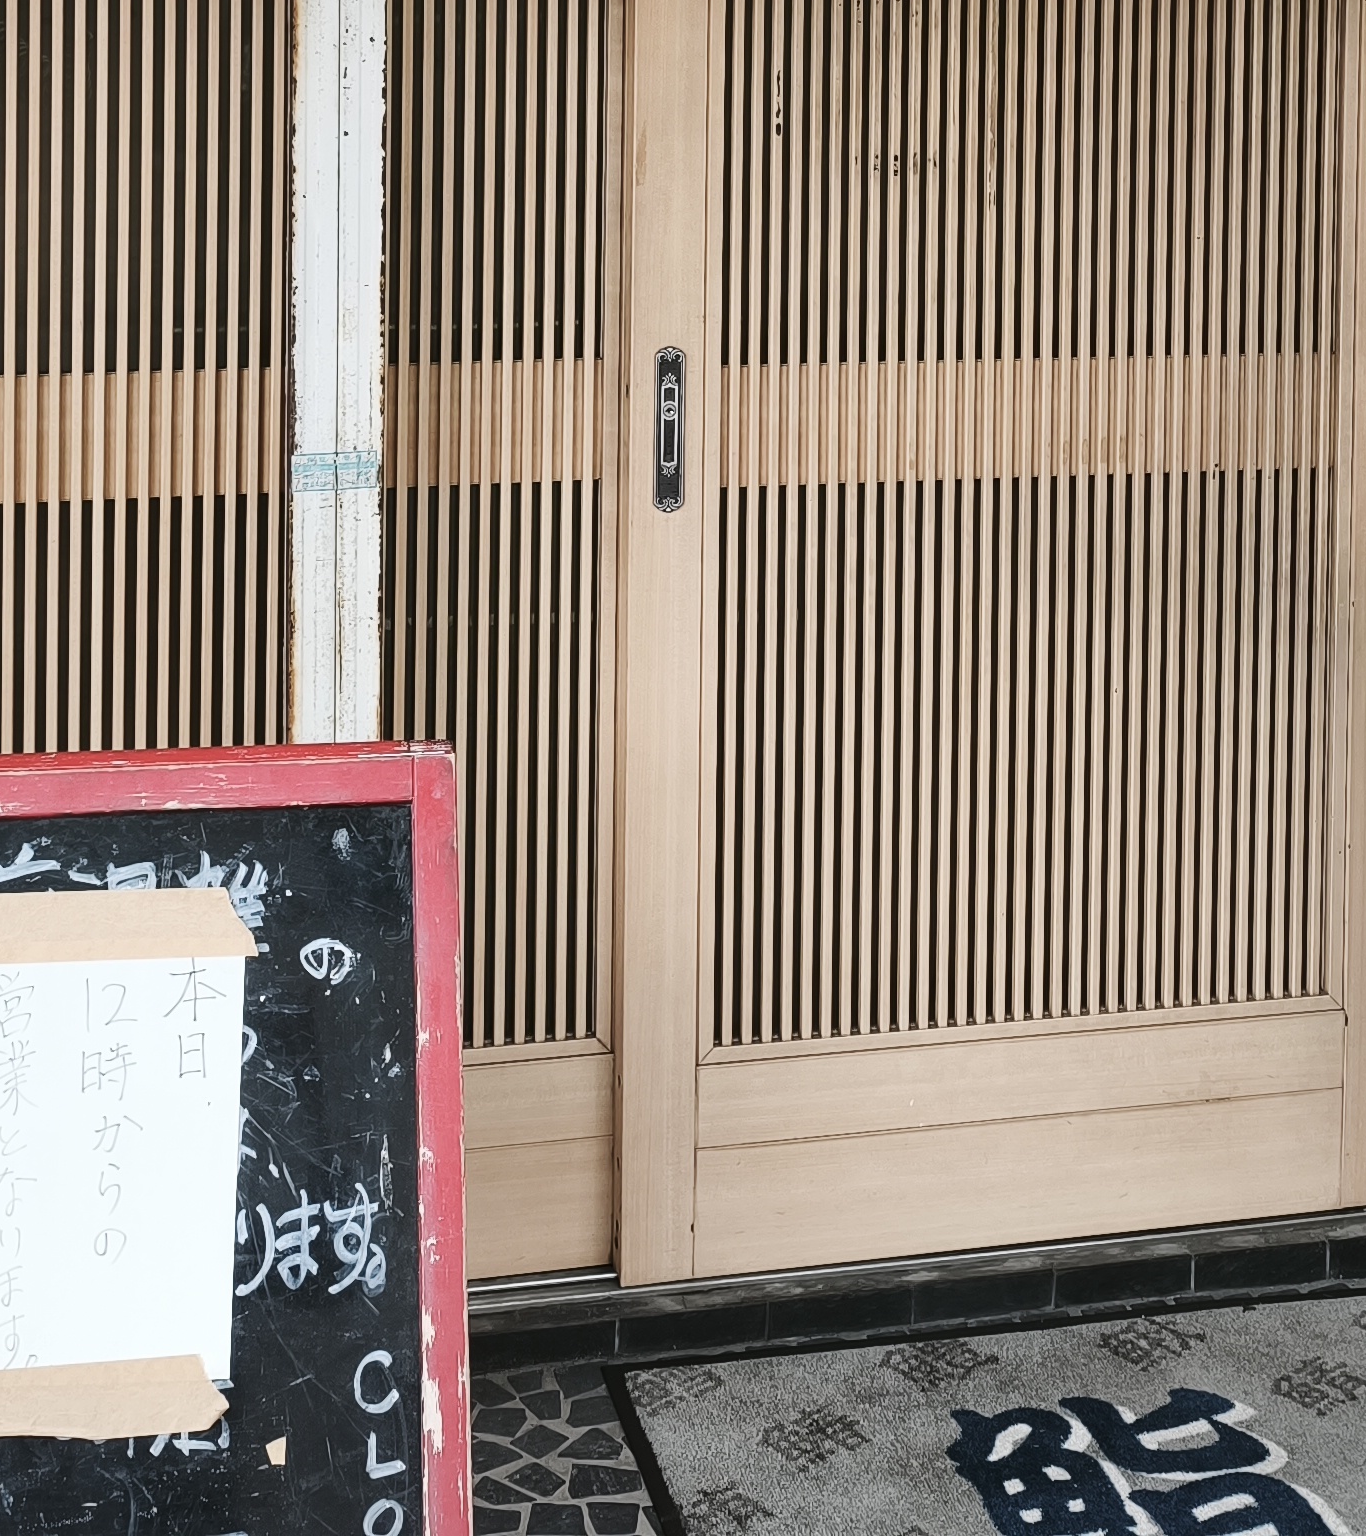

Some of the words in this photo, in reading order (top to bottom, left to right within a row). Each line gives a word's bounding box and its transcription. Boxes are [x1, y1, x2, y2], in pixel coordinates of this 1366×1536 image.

[163, 956, 227, 1079] 本日
[79, 977, 144, 1264] 12時からの
